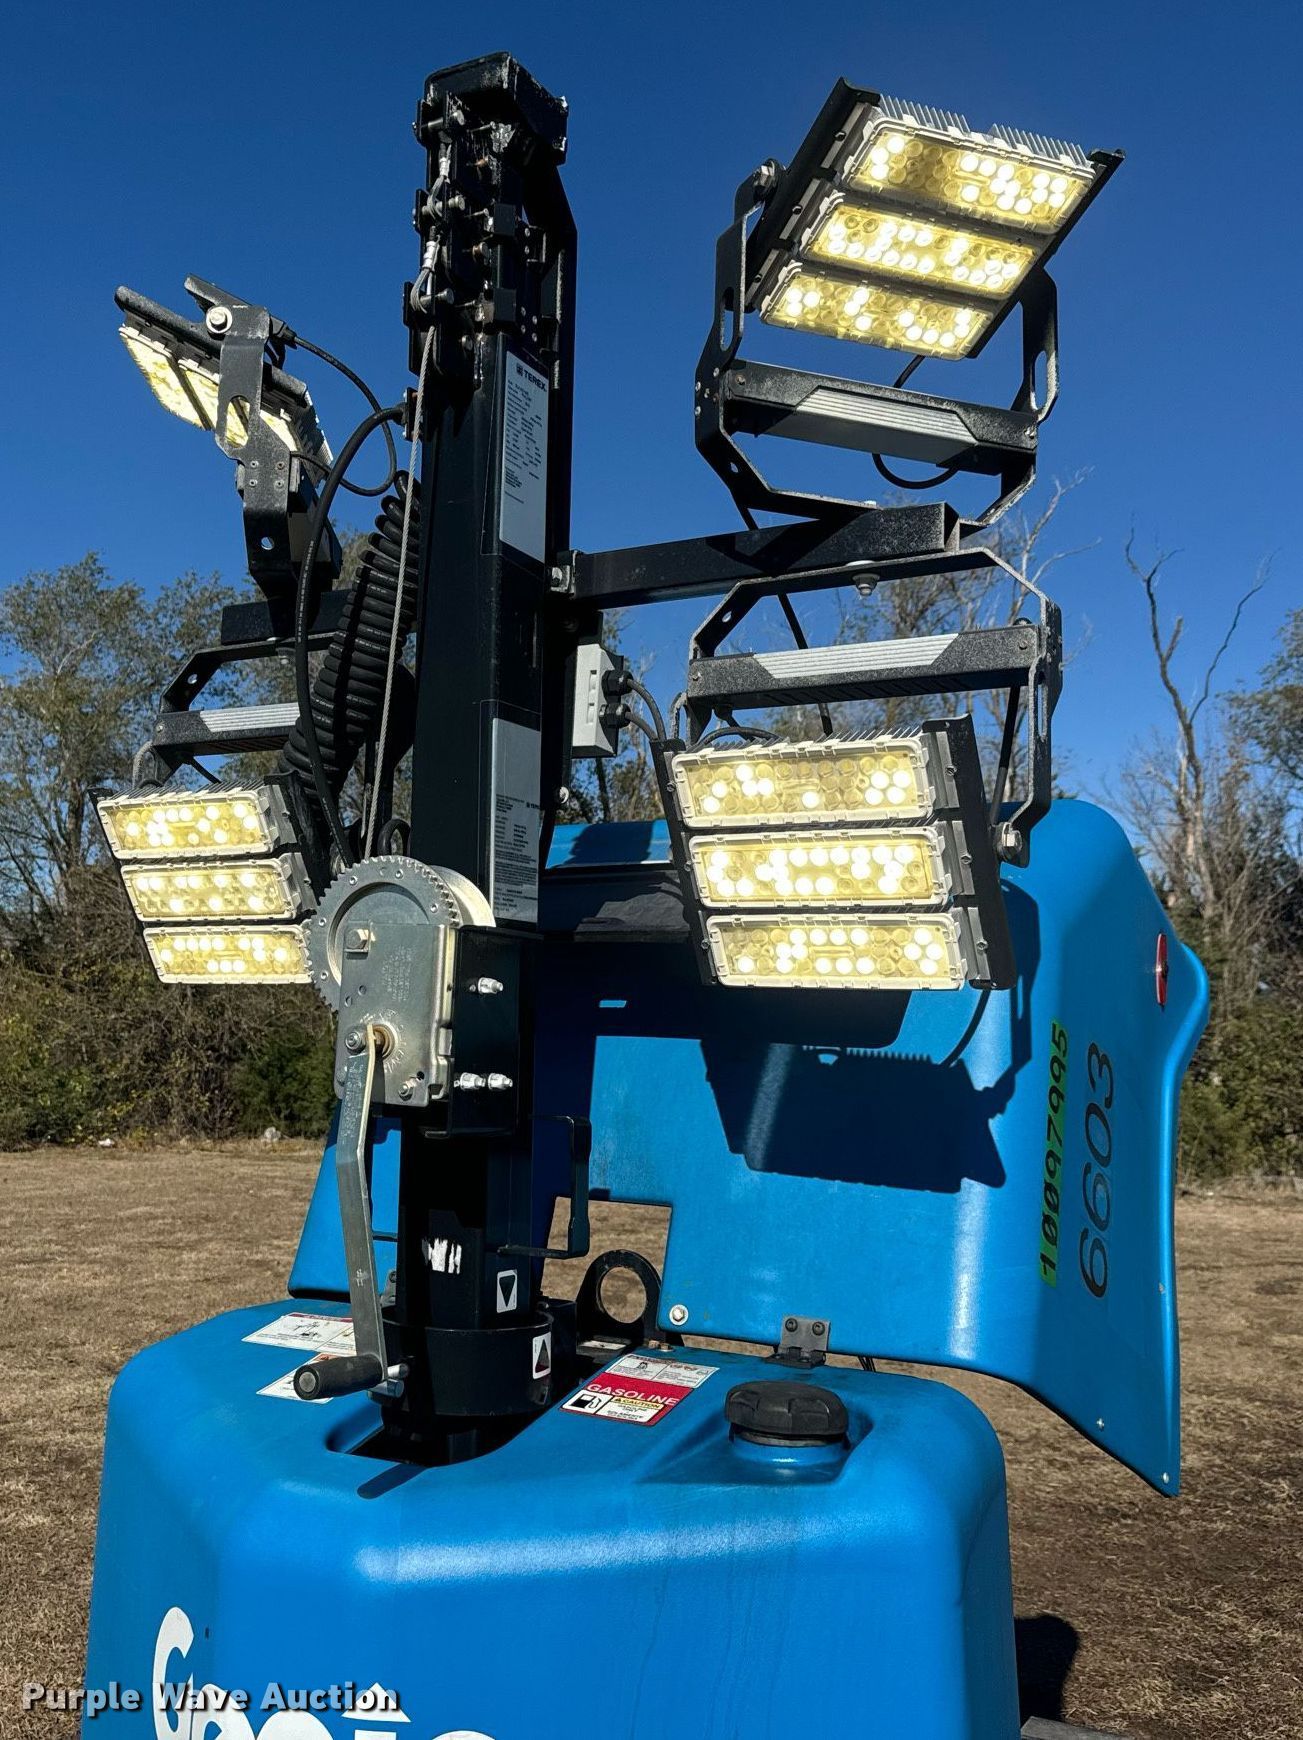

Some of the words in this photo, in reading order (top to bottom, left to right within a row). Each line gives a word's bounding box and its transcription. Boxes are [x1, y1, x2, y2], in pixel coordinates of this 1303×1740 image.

[523, 369, 547, 391] TEREX
[1040, 1023, 1067, 1276] 10097995
[1079, 1041, 1113, 1297] 6603
[586, 1383, 680, 1406] GASOLINE
[621, 1399, 661, 1409] CAUTION
